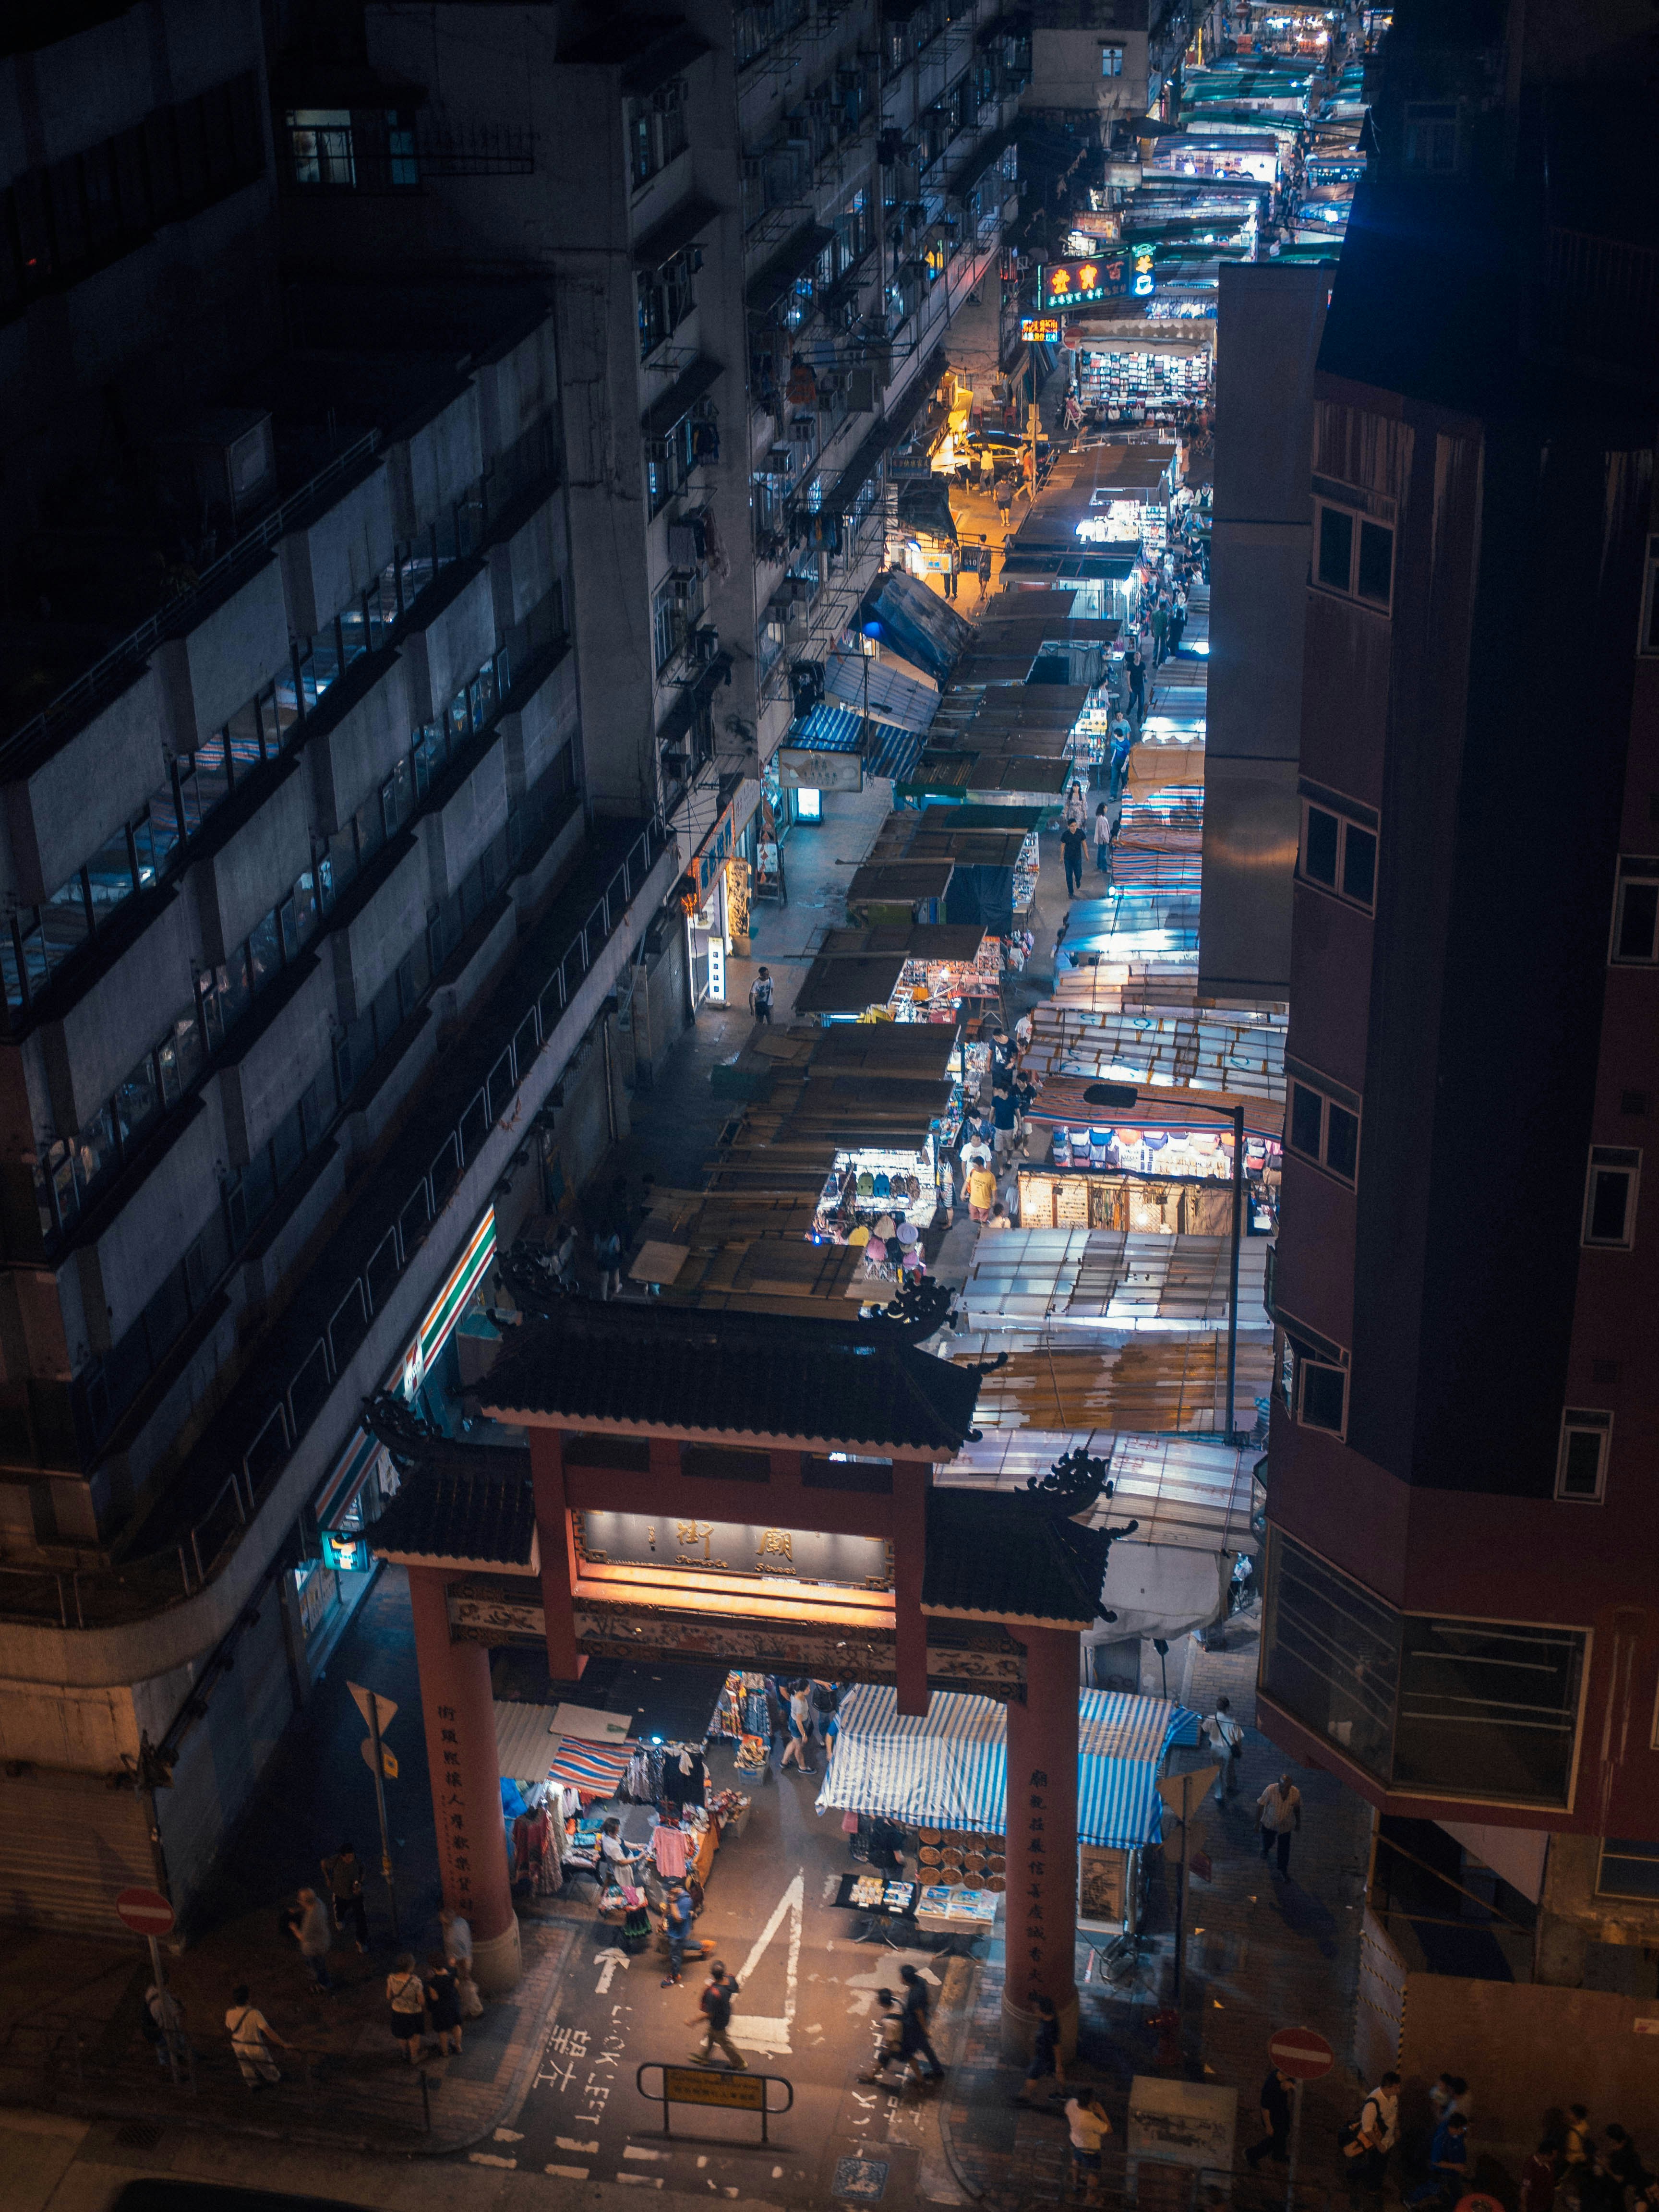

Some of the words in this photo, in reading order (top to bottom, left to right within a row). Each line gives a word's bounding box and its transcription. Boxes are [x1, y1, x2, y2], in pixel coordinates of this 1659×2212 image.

[674, 1554, 729, 1568] Temple
[754, 1562, 797, 1575] Street
[532, 2025, 591, 2092] 望左
